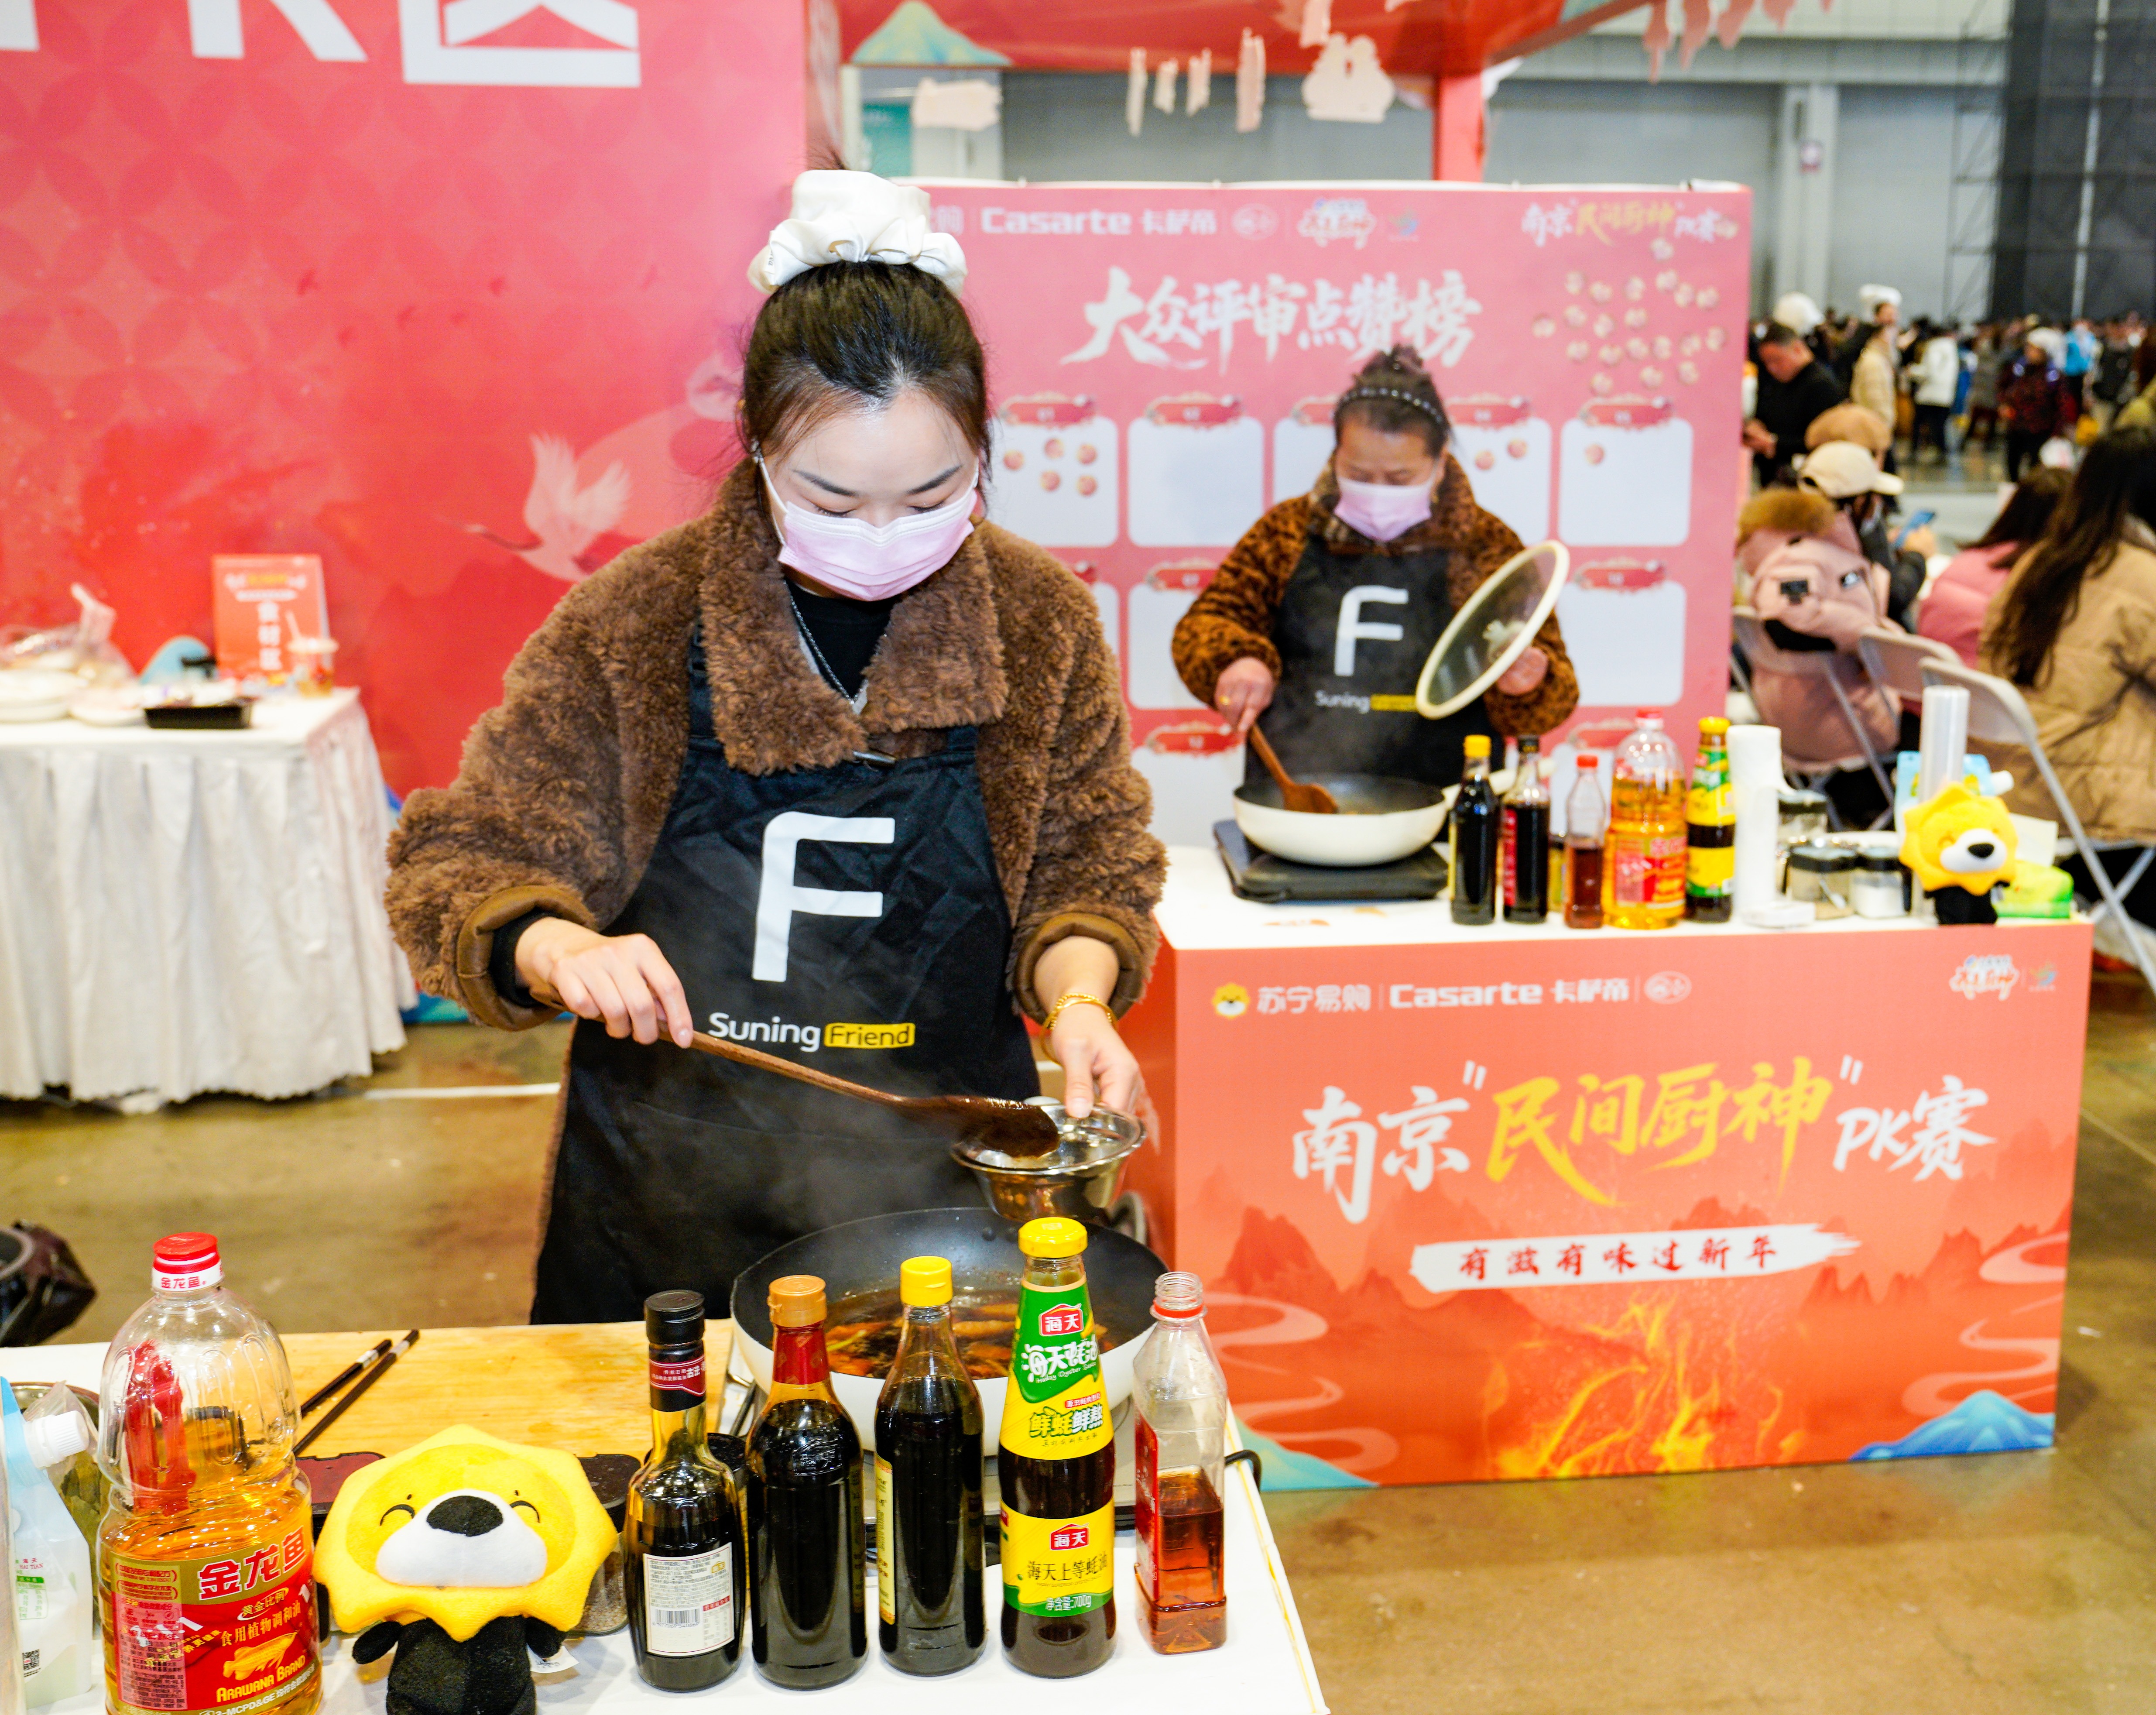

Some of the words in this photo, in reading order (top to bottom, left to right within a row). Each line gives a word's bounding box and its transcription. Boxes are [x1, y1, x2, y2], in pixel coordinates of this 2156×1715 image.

[981, 207, 1132, 235] Casarte
[1141, 208, 1217, 235] 卡萨帝
[1059, 265, 1482, 376] 大众评审点赞榜
[1334, 585, 1409, 677] F
[752, 811, 895, 982] F
[1256, 984, 1371, 1015] 苏宁易购
[1389, 981, 1542, 1008] Casarte
[1550, 978, 1629, 1003] 卡萨帝
[709, 1012, 821, 1053] Suning
[829, 1025, 911, 1046] Friend
[1459, 1234, 1777, 1280] 有滋有味过新年
[160, 1276, 201, 1290] 金龙鱼
[1045, 1313, 1079, 1332] 海天
[1021, 1334, 1098, 1382] 海天蚝油
[1058, 1367, 1081, 1377] Oyster
[1029, 1404, 1104, 1438] 鲜蚝鲜熬
[1054, 1531, 1086, 1547] 海天
[198, 1525, 307, 1601] 金龙鱼
[1027, 1550, 1108, 1581] 海天上等蚝油
[241, 1591, 285, 1617] 黄金比例
[220, 1599, 301, 1647] 食用植物调和油
